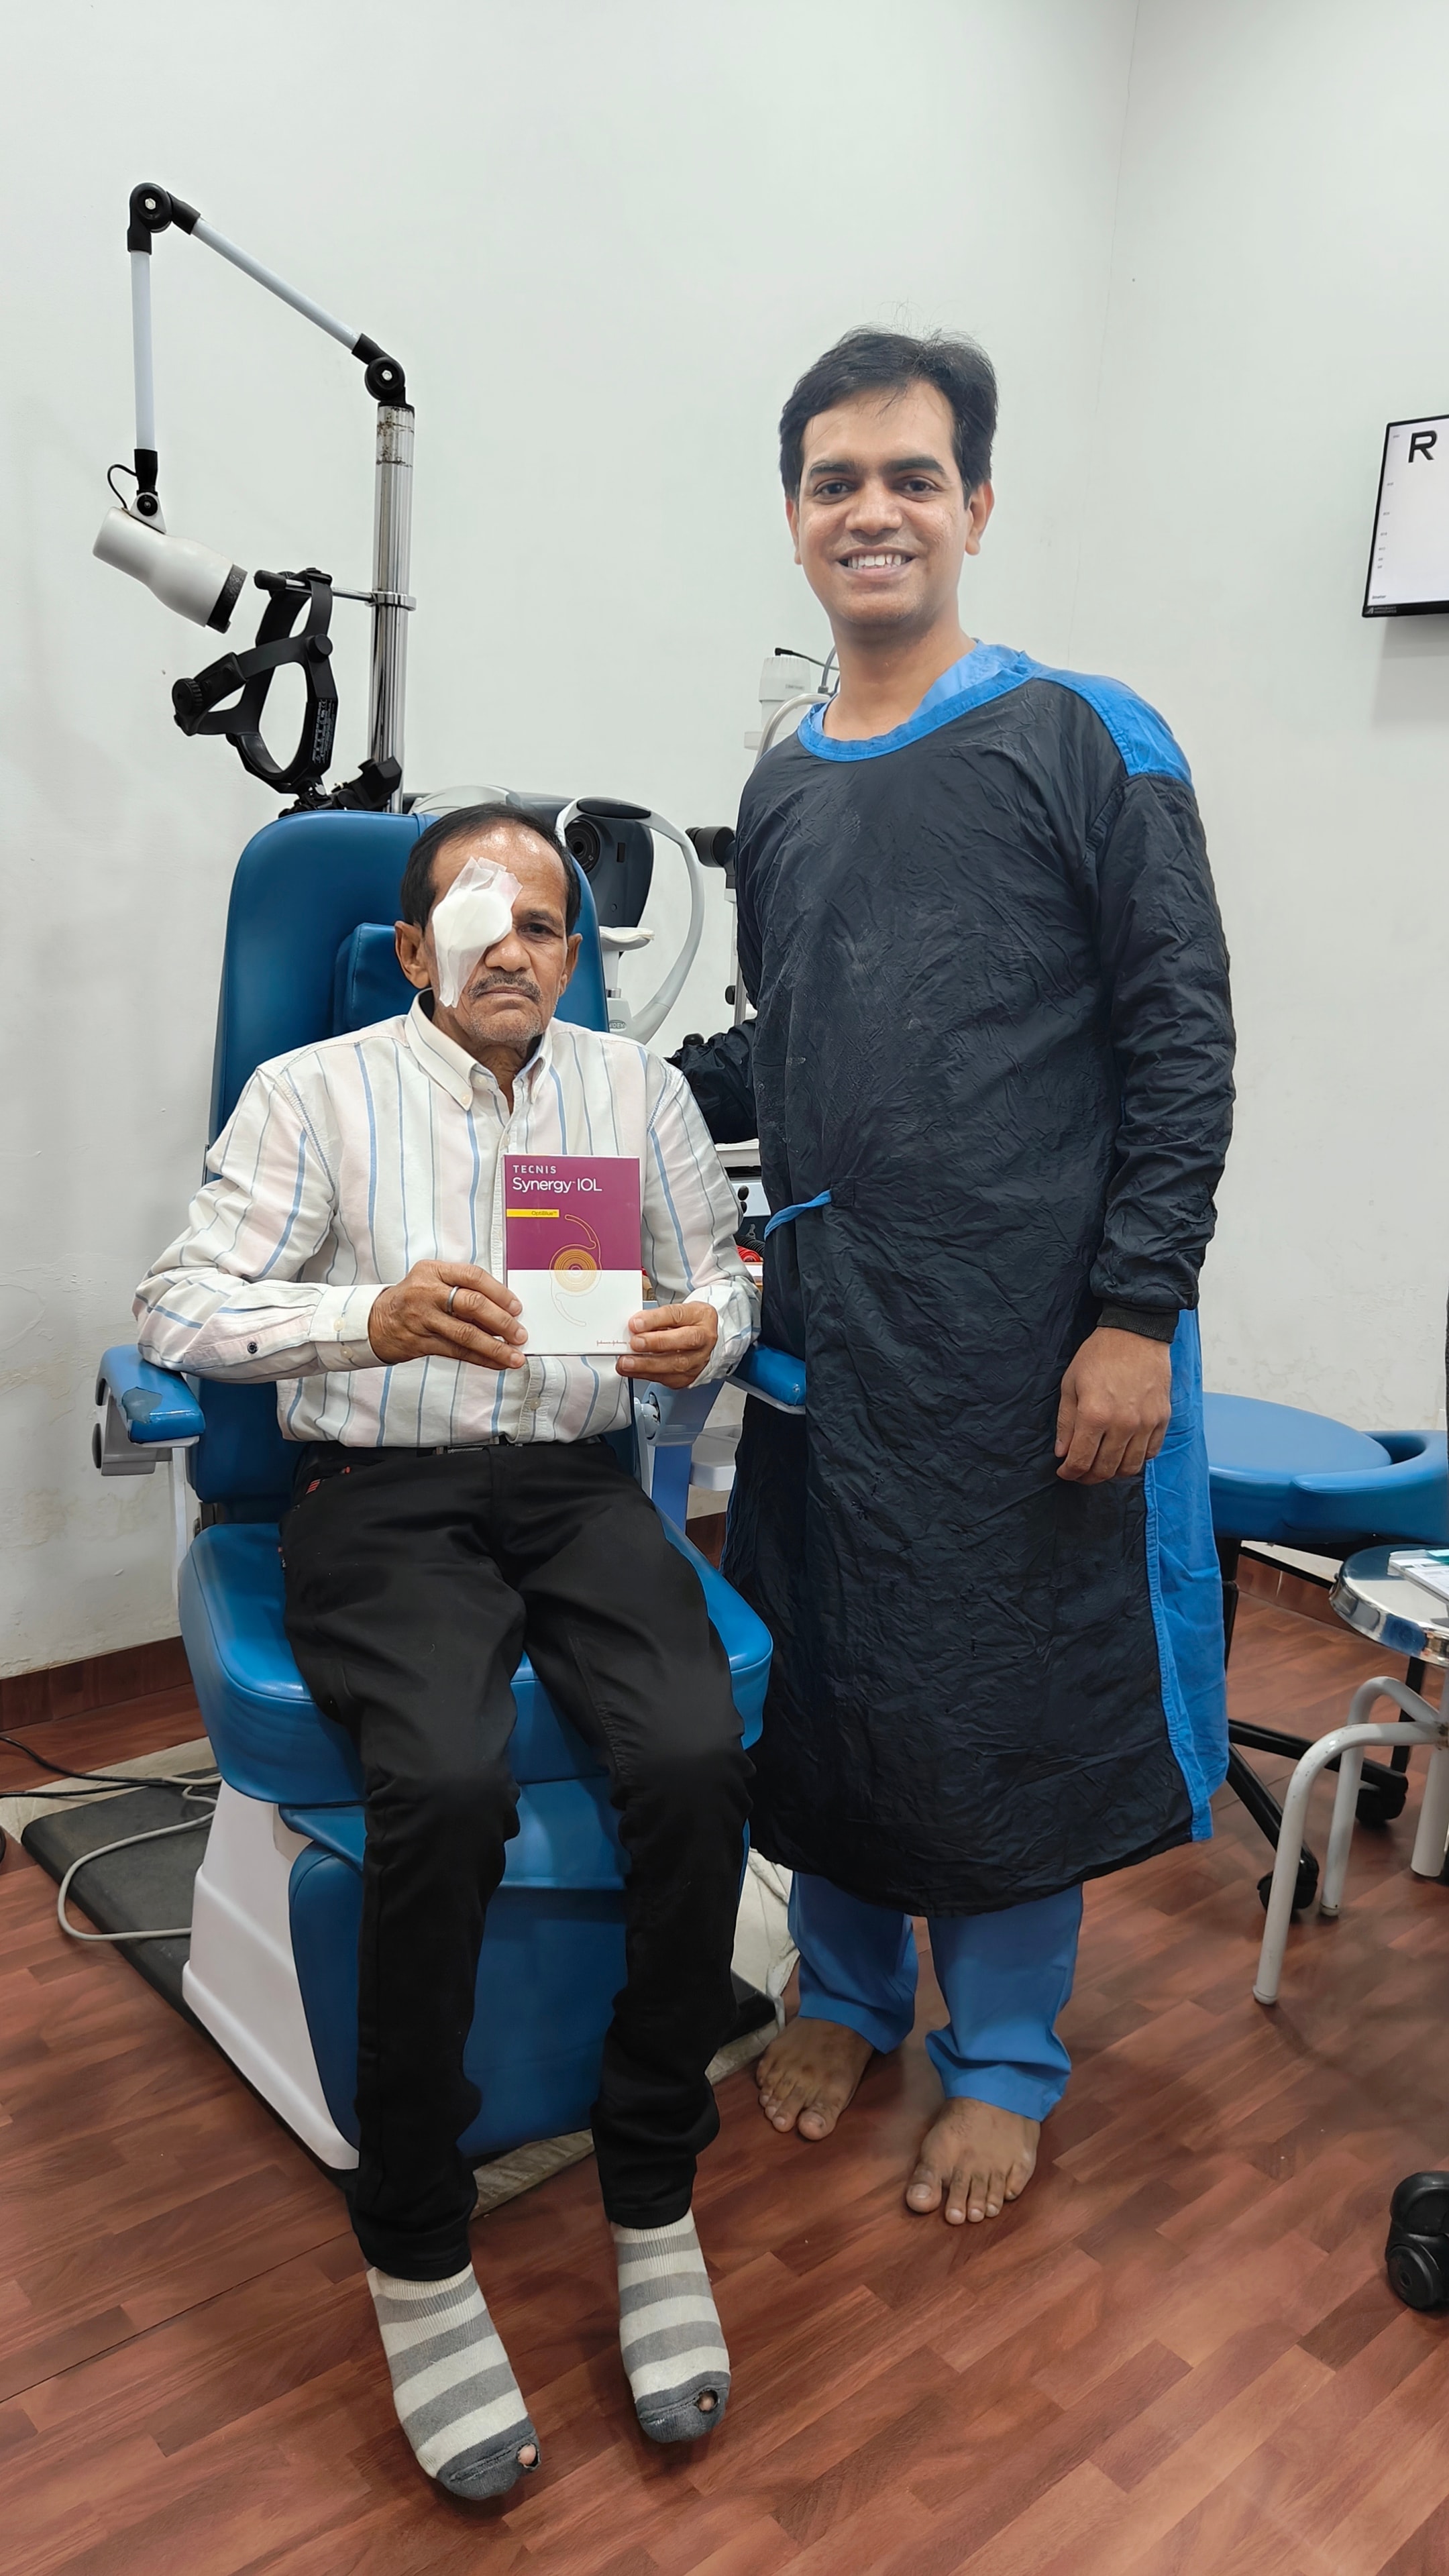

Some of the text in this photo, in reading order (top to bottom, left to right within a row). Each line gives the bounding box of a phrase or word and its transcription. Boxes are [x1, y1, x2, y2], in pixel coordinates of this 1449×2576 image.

[1408, 430, 1437, 463] R
[513, 1165, 557, 1174] TECNIS
[512, 1177, 602, 1193] Synergy IOL
